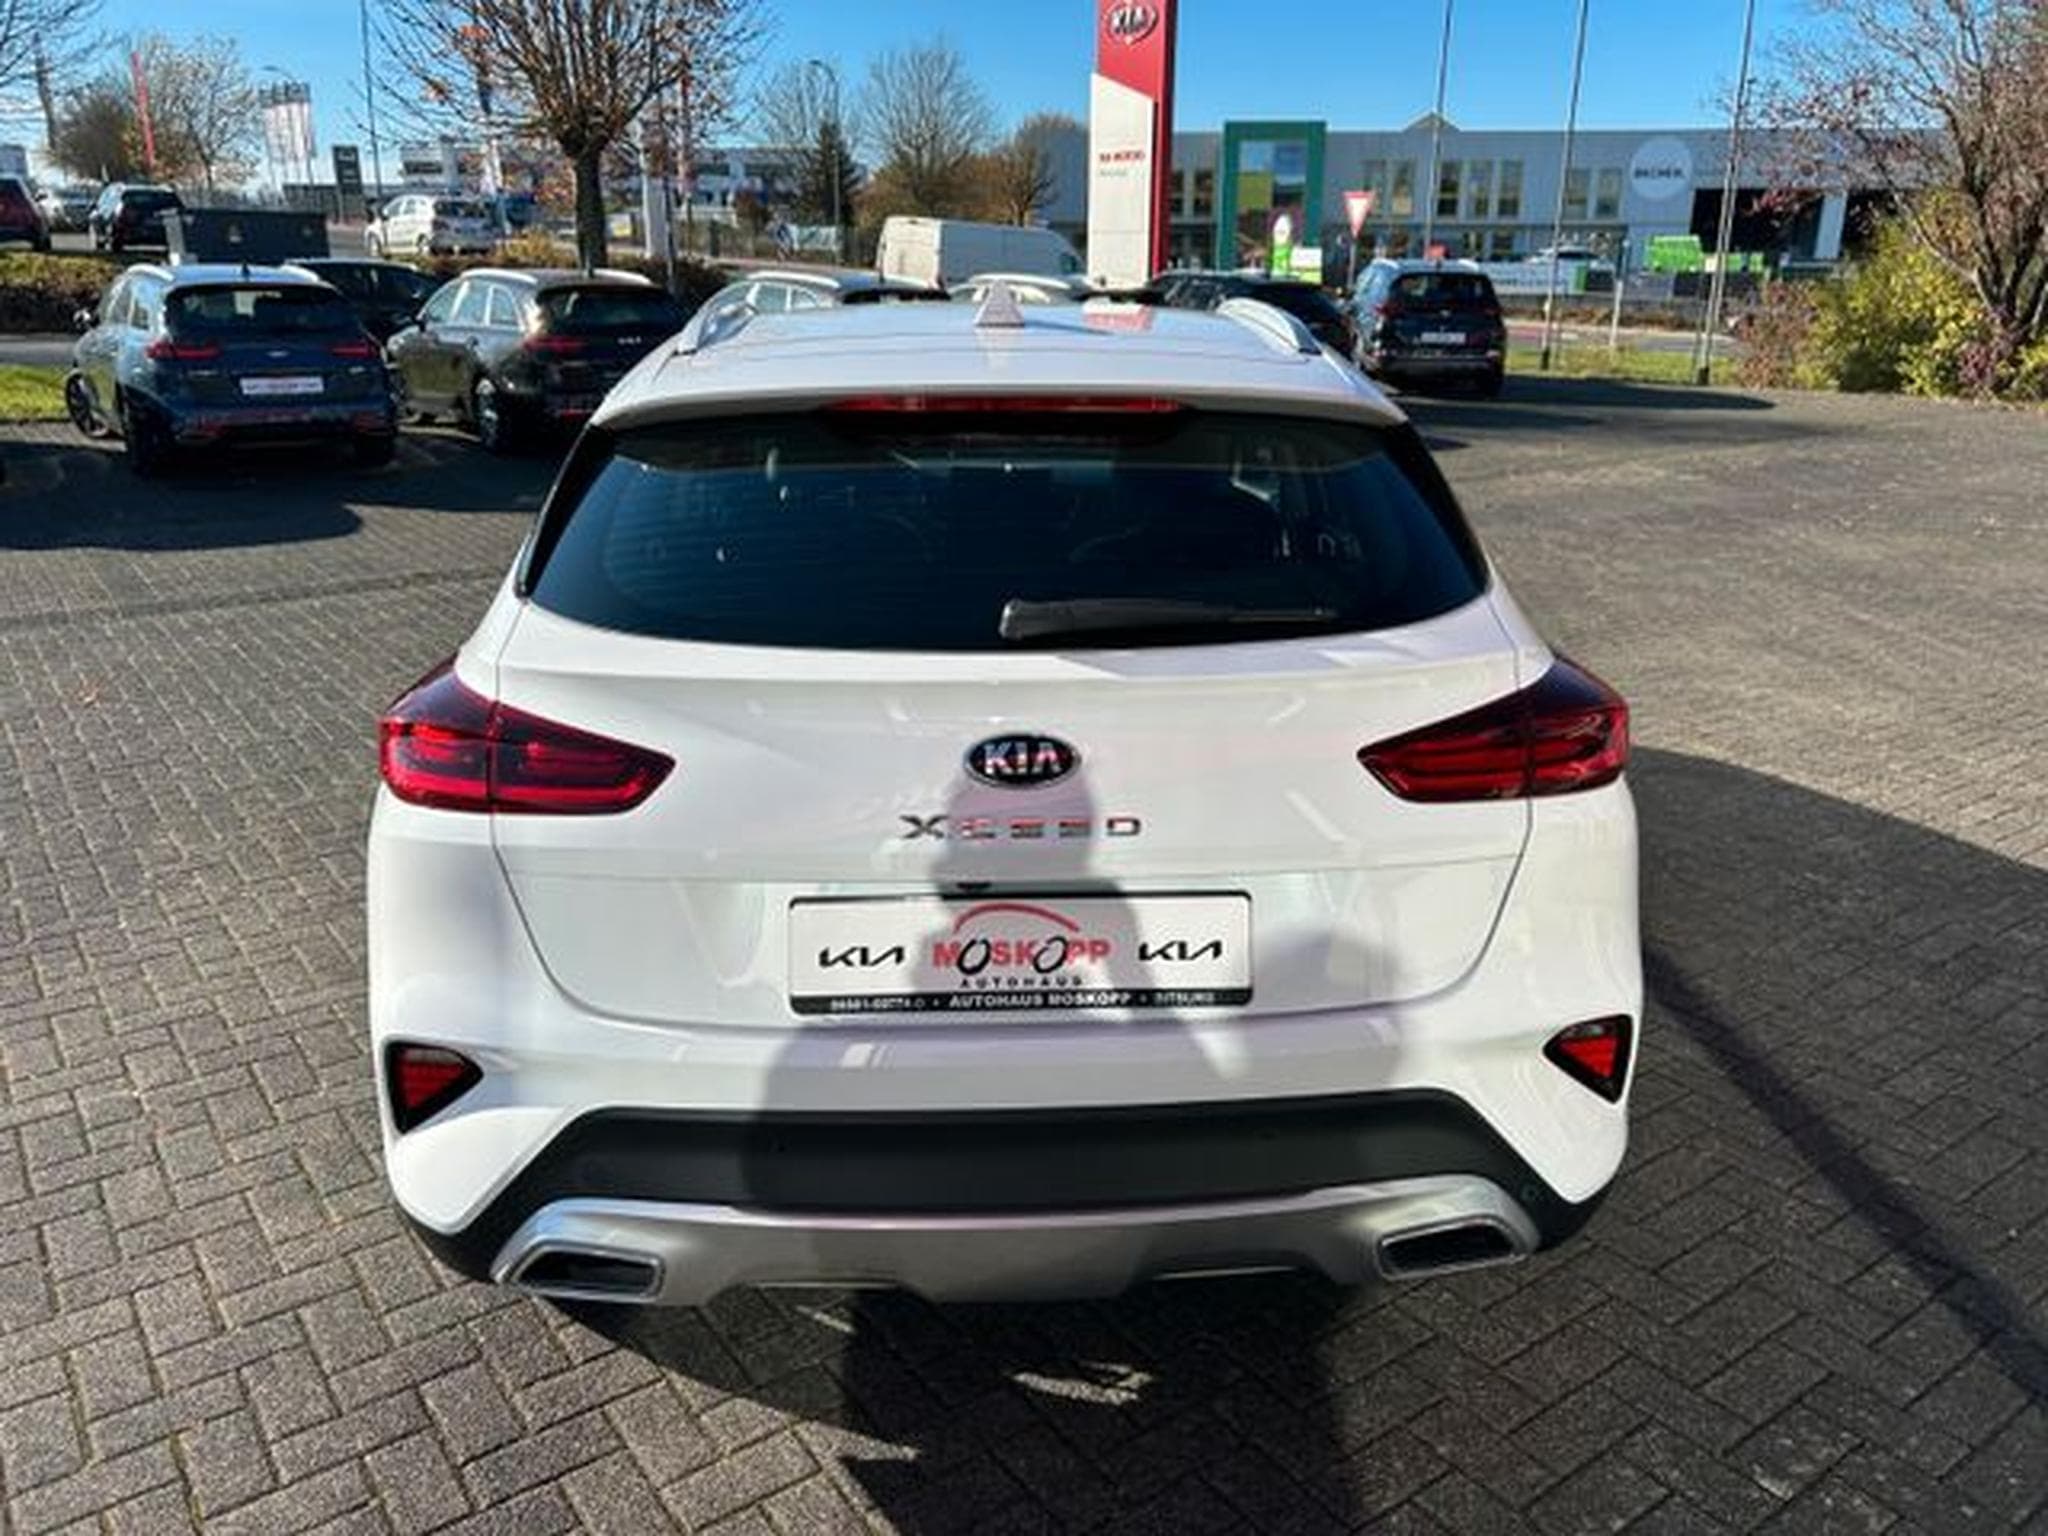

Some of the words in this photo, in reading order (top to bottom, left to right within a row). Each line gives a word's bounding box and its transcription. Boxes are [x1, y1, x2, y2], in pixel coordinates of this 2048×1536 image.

[984, 741, 1063, 776] KIA
[899, 814, 1143, 839] XCEED
[818, 945, 905, 968] KIA
[932, 935, 1112, 975] MOSKOPP
[1138, 939, 1223, 962] KIA
[959, 976, 1083, 988] AUTOHAUS
[948, 993, 1043, 1009] AUTOHAUS
[1048, 992, 1132, 1008] MOSKOPP
